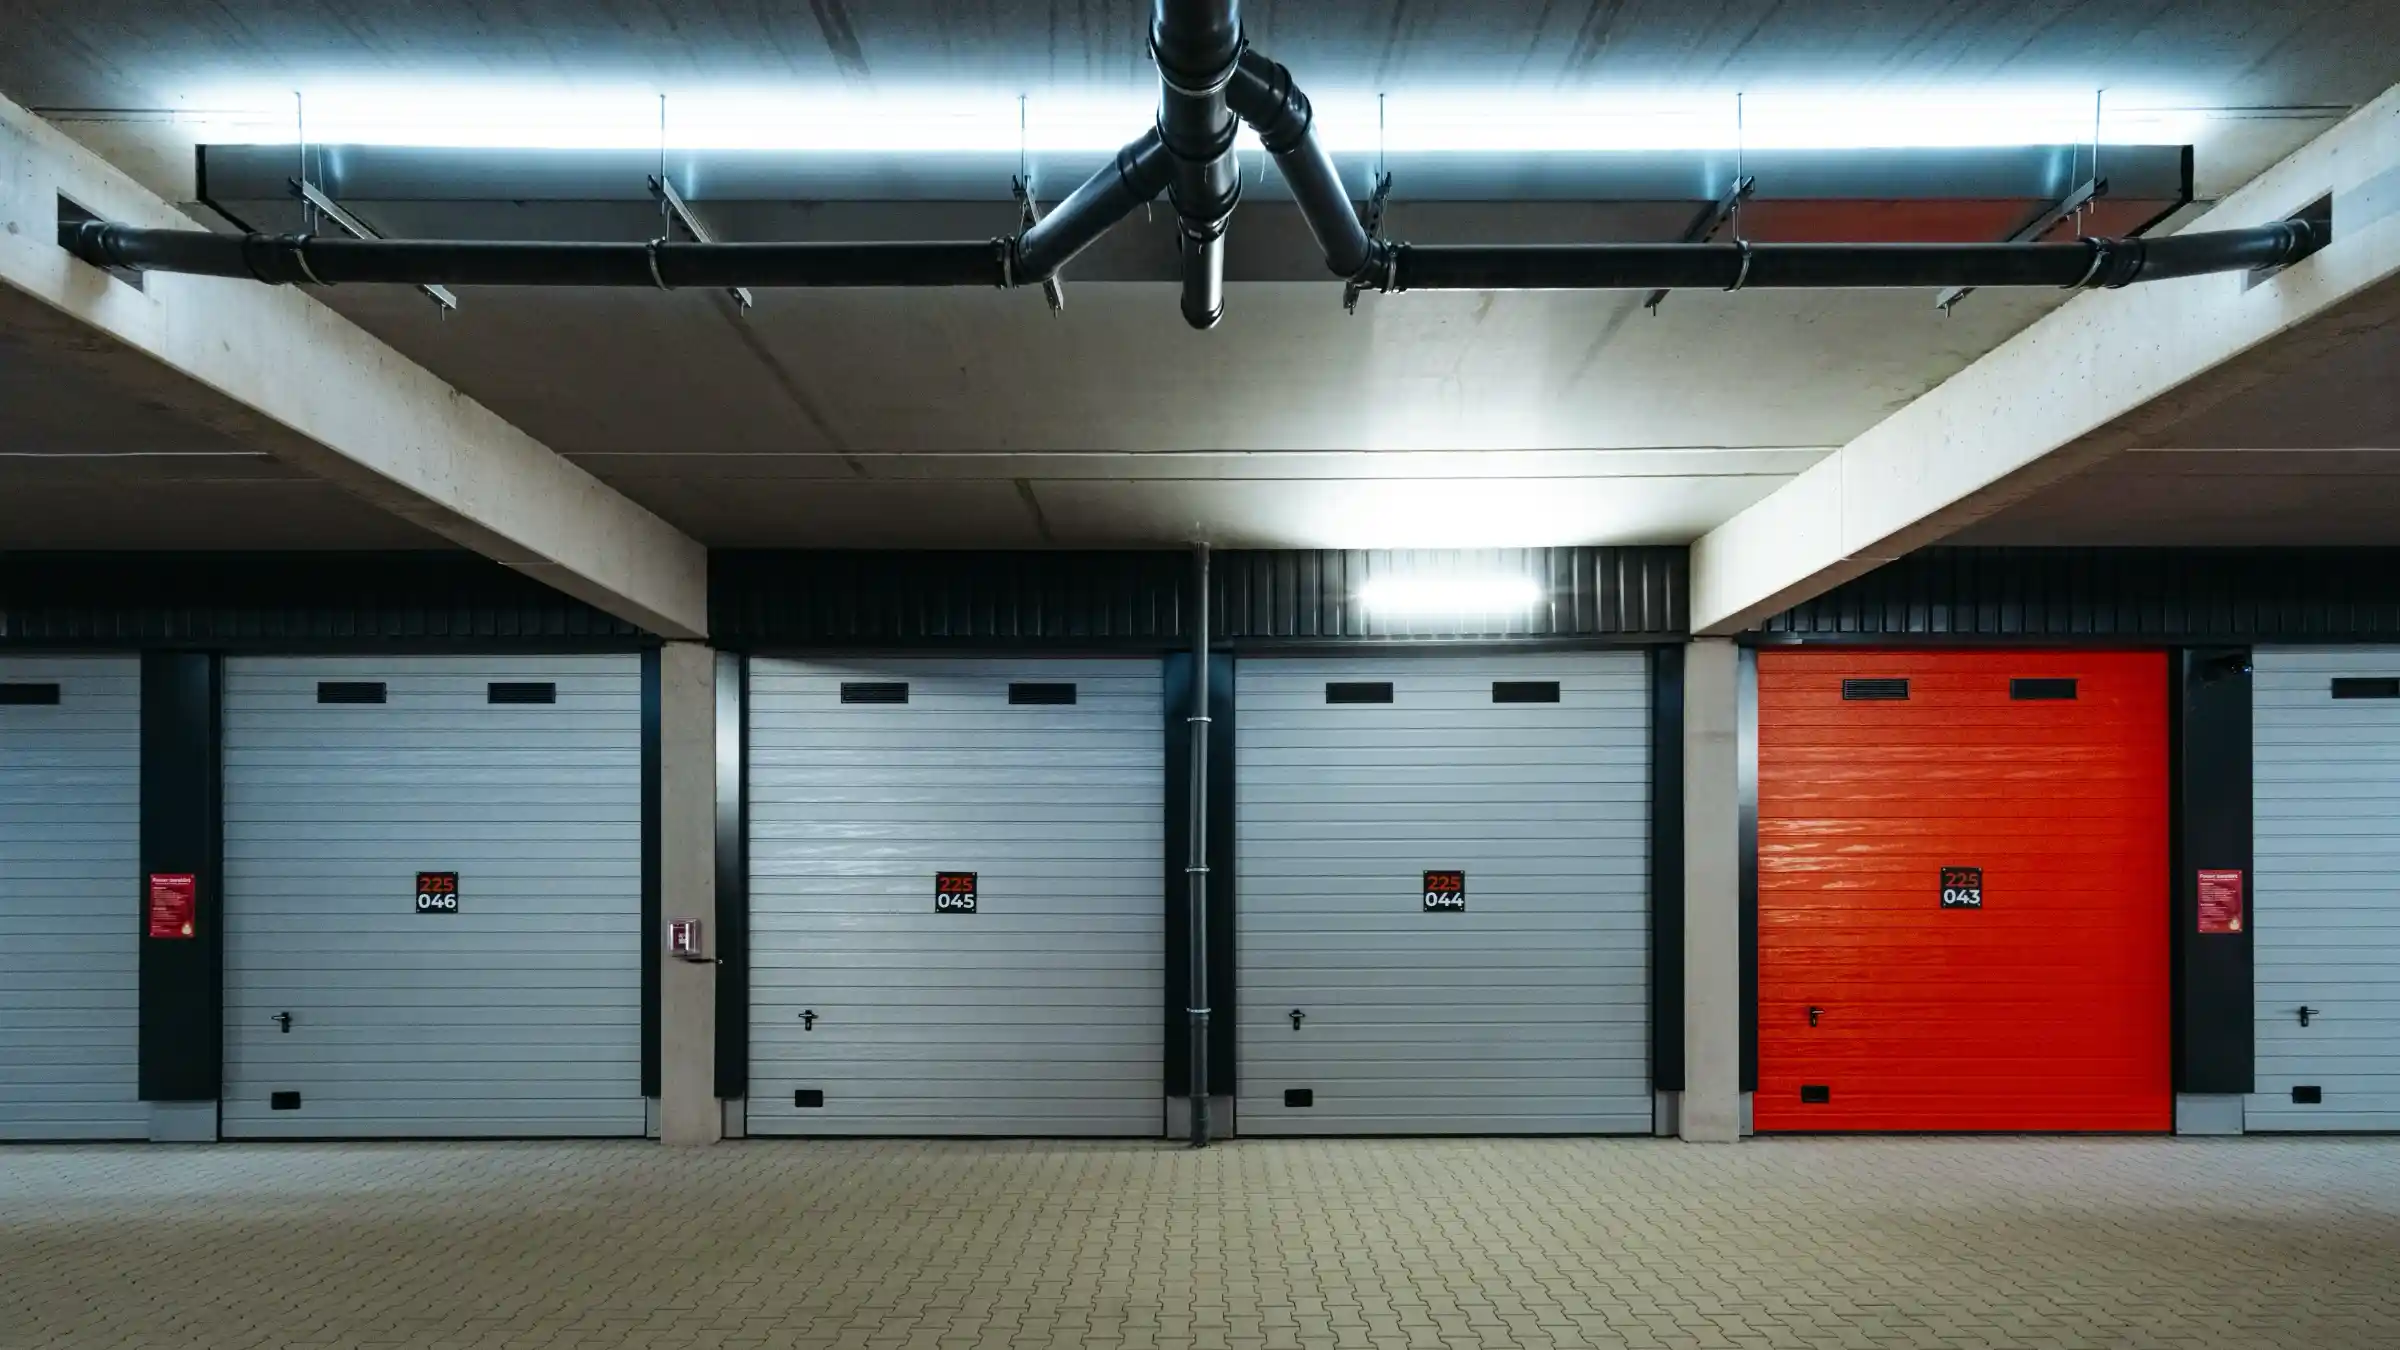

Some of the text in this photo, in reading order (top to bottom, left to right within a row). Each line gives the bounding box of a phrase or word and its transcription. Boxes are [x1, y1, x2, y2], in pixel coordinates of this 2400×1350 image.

[420, 877, 454, 891] 225
[939, 877, 972, 891] 225
[1428, 876, 1460, 890] 225
[1945, 873, 1978, 887] 225
[418, 893, 456, 908] 046
[938, 893, 974, 908] 045
[1425, 892, 1464, 906] 044
[1944, 889, 1980, 904] 043
